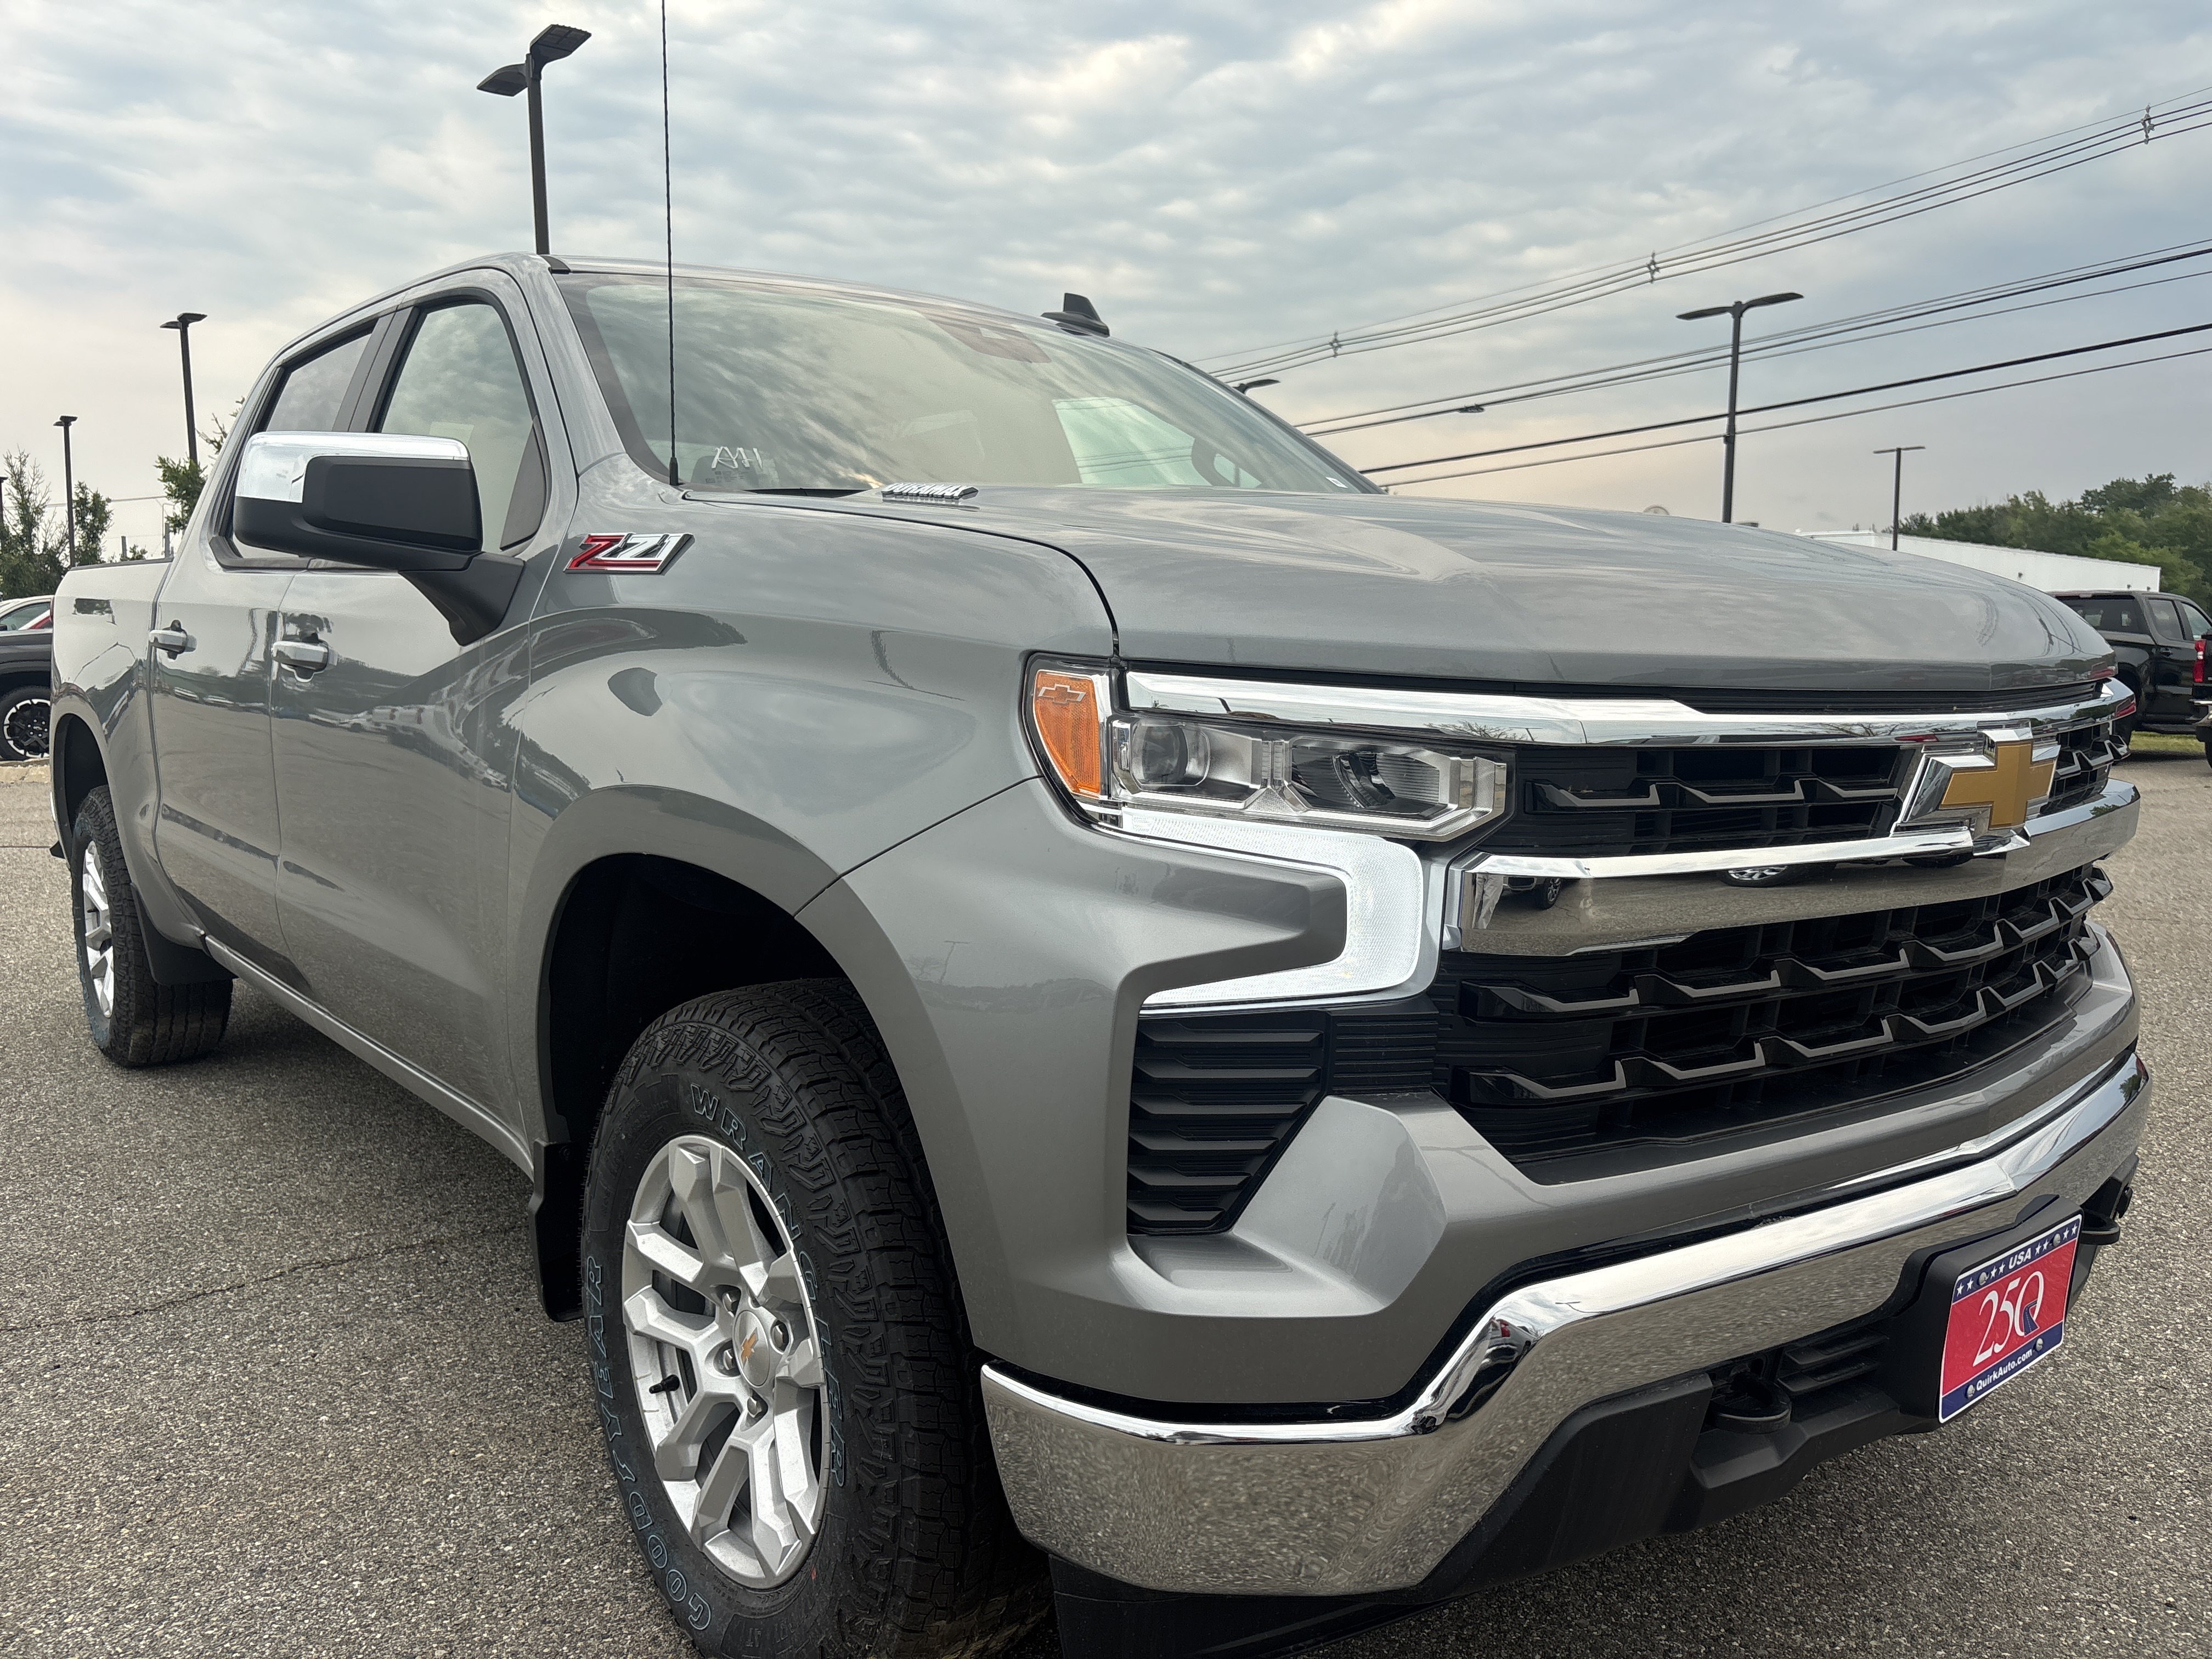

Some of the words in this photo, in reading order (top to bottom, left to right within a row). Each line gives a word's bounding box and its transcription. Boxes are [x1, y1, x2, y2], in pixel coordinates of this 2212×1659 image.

[881, 482, 968, 500] DURAMAX
[563, 533, 693, 575] Z71
[2008, 1247, 2032, 1270] USA
[691, 1084, 845, 1487] WRANGLER
[1976, 1348, 2033, 1392] QuirkAuto.com
[587, 1256, 711, 1630] GOODYEAR
